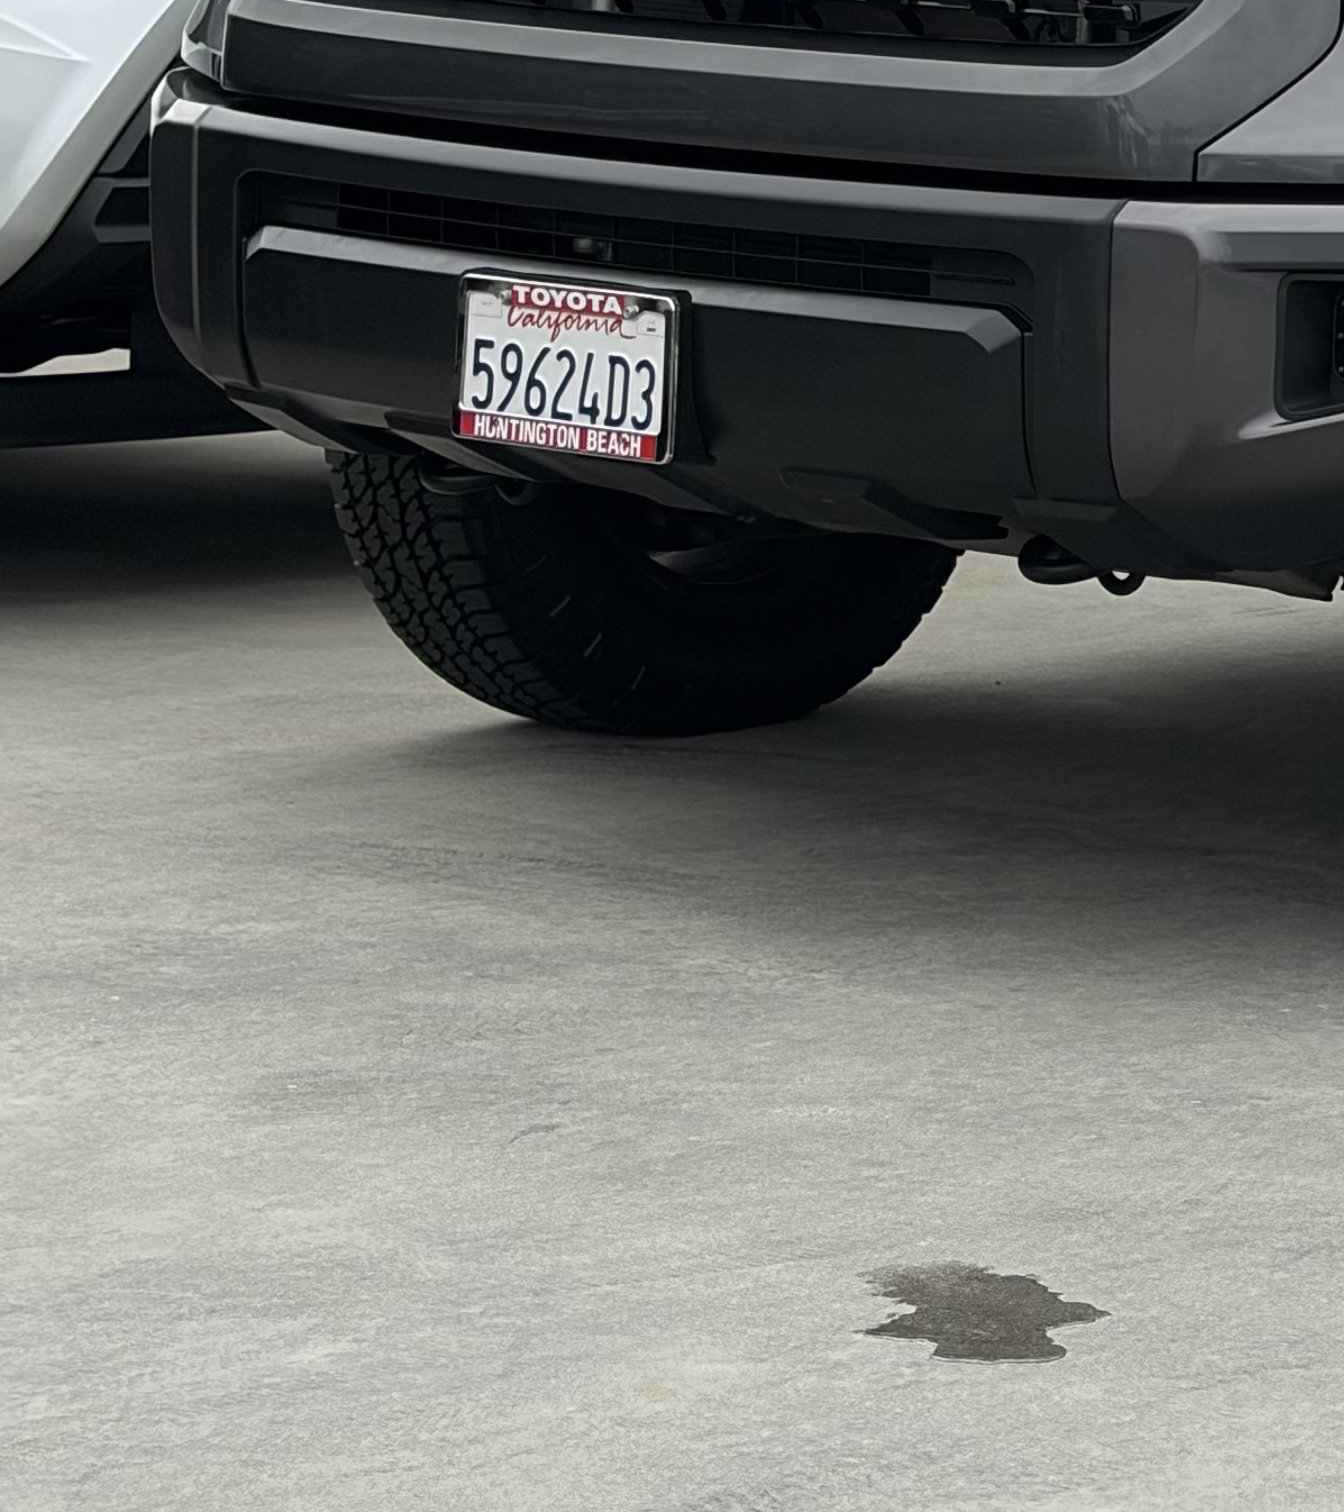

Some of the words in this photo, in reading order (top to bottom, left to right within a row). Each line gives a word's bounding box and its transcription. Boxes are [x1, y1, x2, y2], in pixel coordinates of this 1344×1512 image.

[512, 285, 623, 315] TOYOTA
[507, 305, 637, 343] California
[471, 338, 657, 430] 59624D3
[473, 414, 580, 449] HUNTINGTON
[586, 432, 642, 458] BEACH
